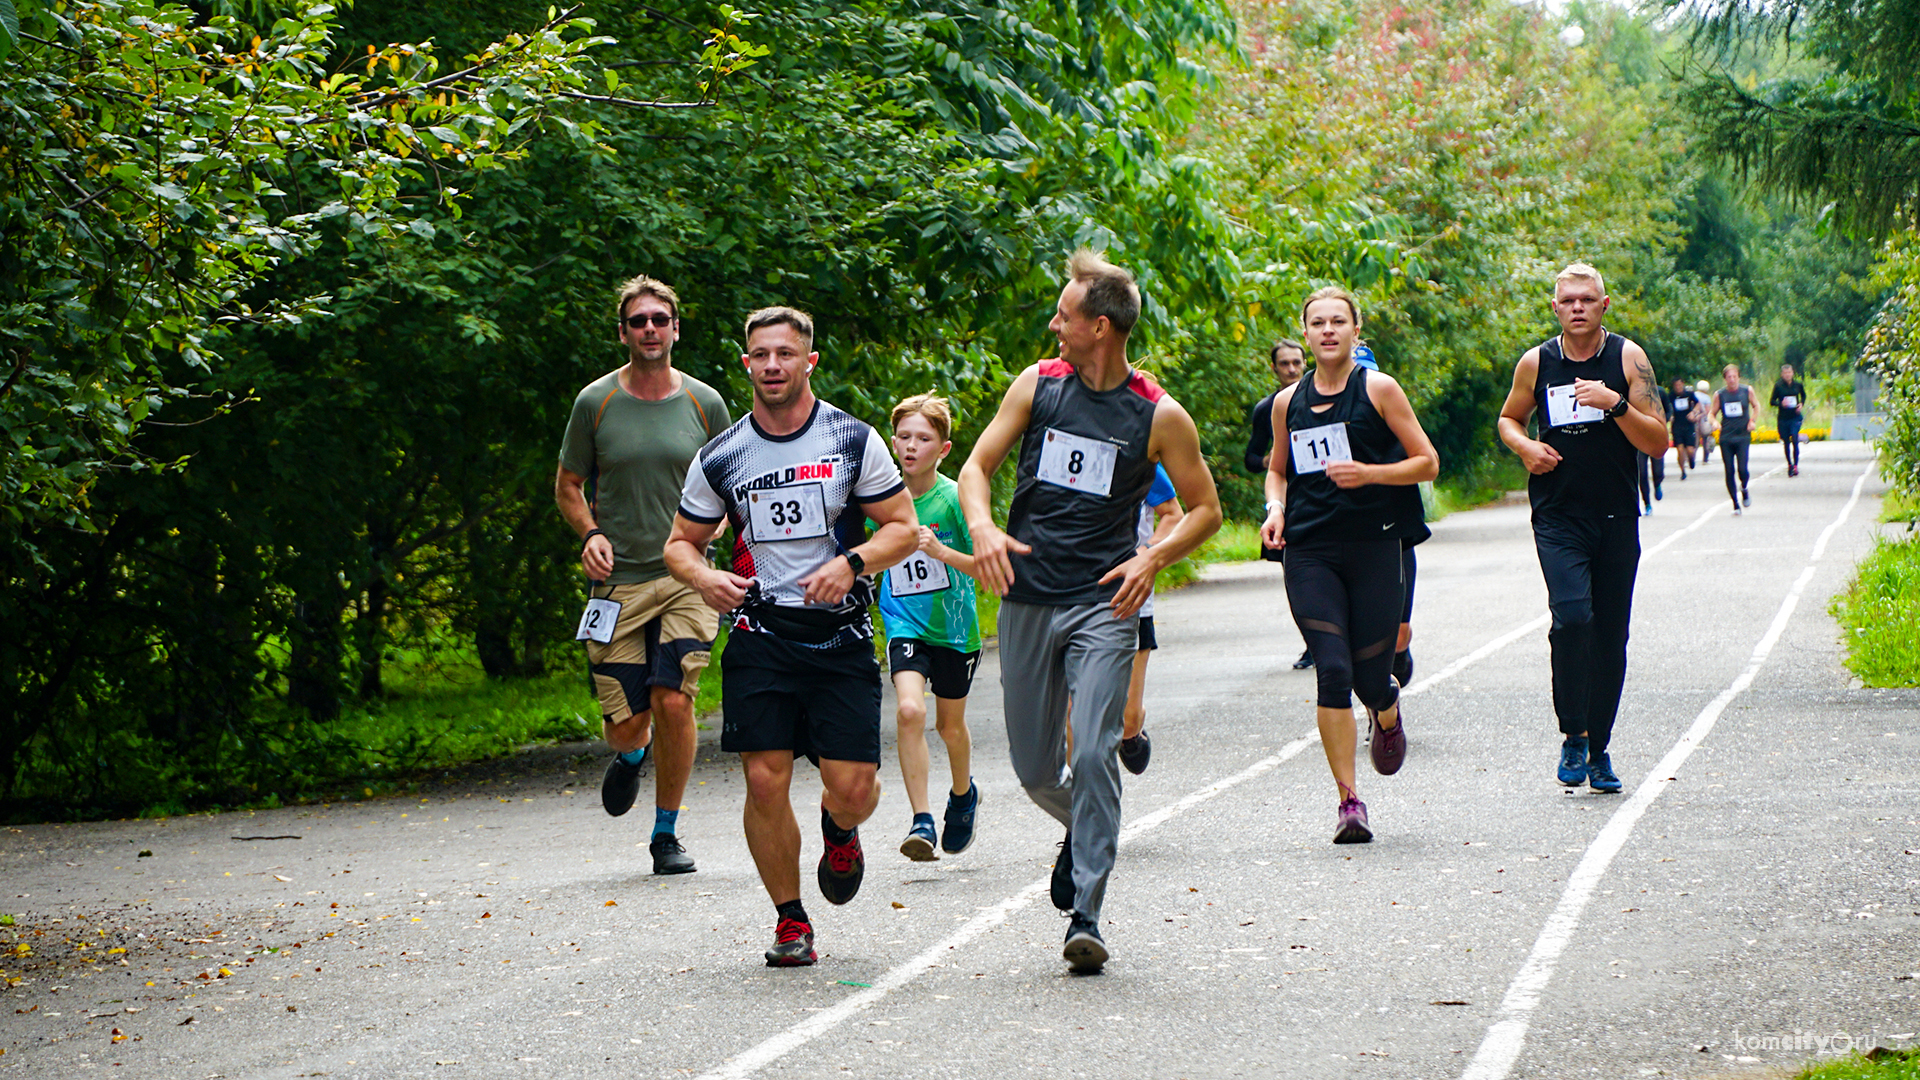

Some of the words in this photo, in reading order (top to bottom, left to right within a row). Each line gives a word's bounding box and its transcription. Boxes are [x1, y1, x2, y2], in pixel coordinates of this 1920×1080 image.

[1307, 437, 1331, 459] 11
[1068, 450, 1084, 474] 8
[770, 500, 802, 526] 33
[903, 560, 928, 582] 16
[584, 609, 601, 629] 12
[966, 656, 975, 680] 7
